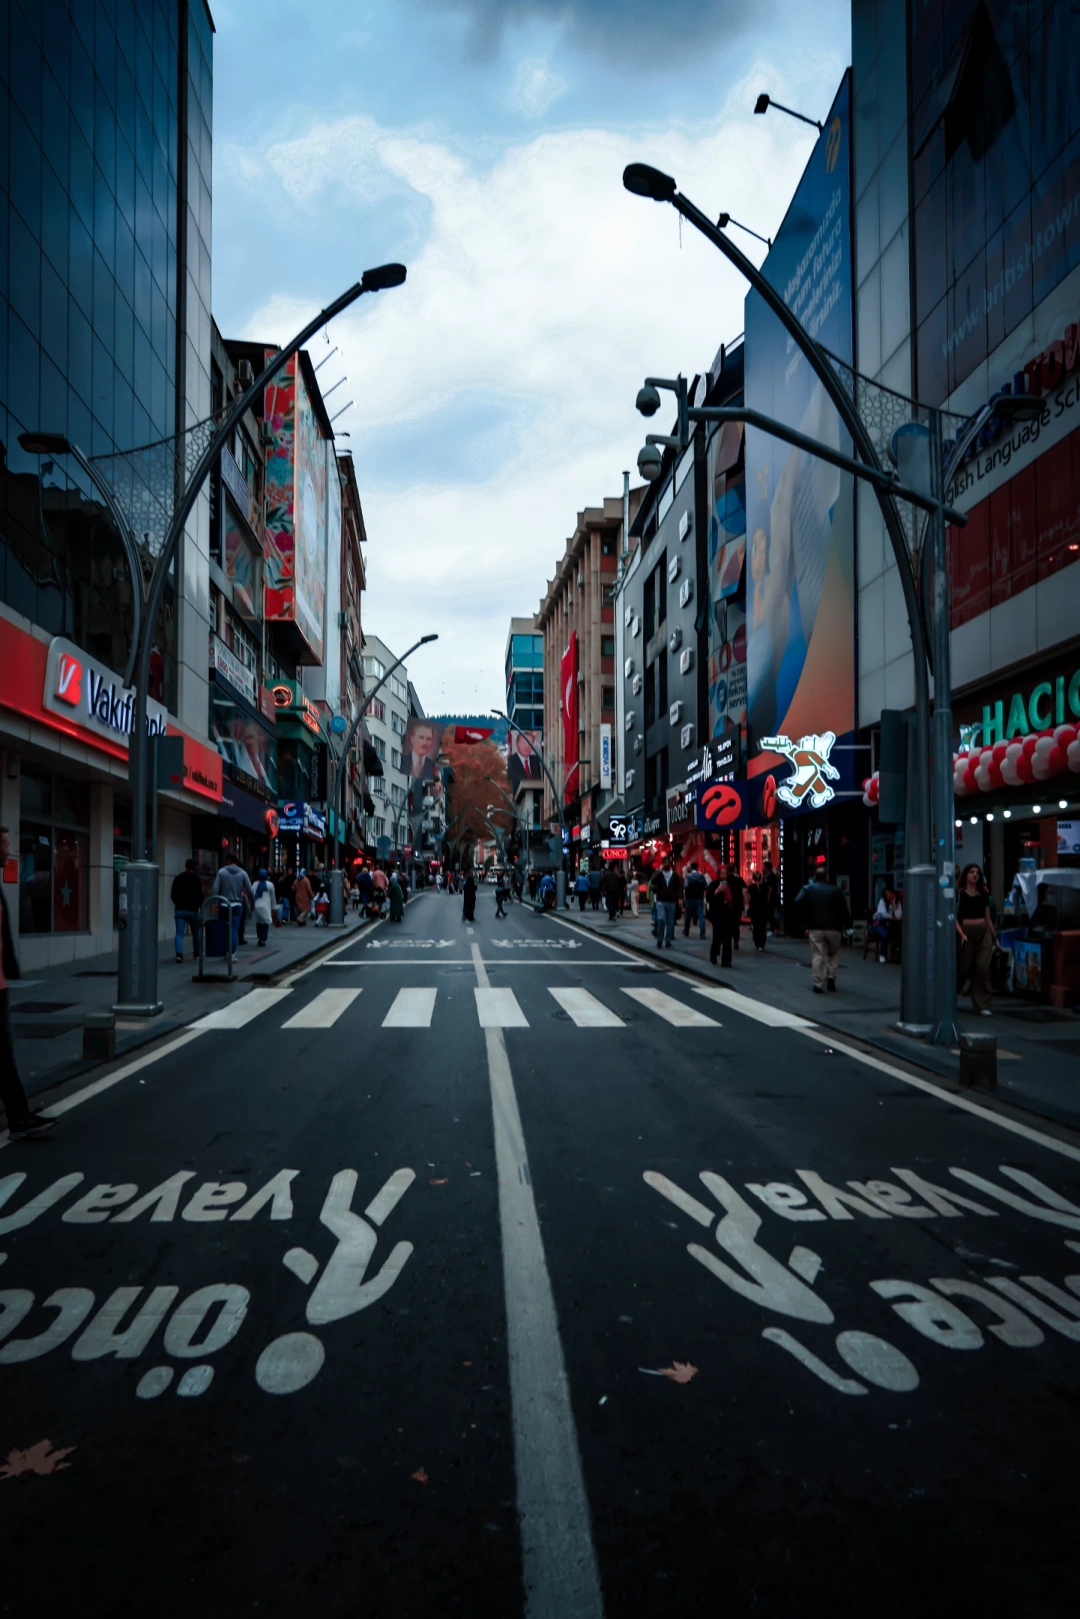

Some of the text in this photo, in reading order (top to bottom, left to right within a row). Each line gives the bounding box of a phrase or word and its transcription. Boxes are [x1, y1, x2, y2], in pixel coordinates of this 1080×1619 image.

[783, 187, 842, 304] Mağazamızda
[812, 215, 843, 280] fatura
[944, 472, 974, 508] glish
[977, 410, 1051, 482] Language
[61, 1169, 301, 1222] yaya
[743, 1167, 1000, 1222] yaya
[869, 1273, 1080, 1350] nce
